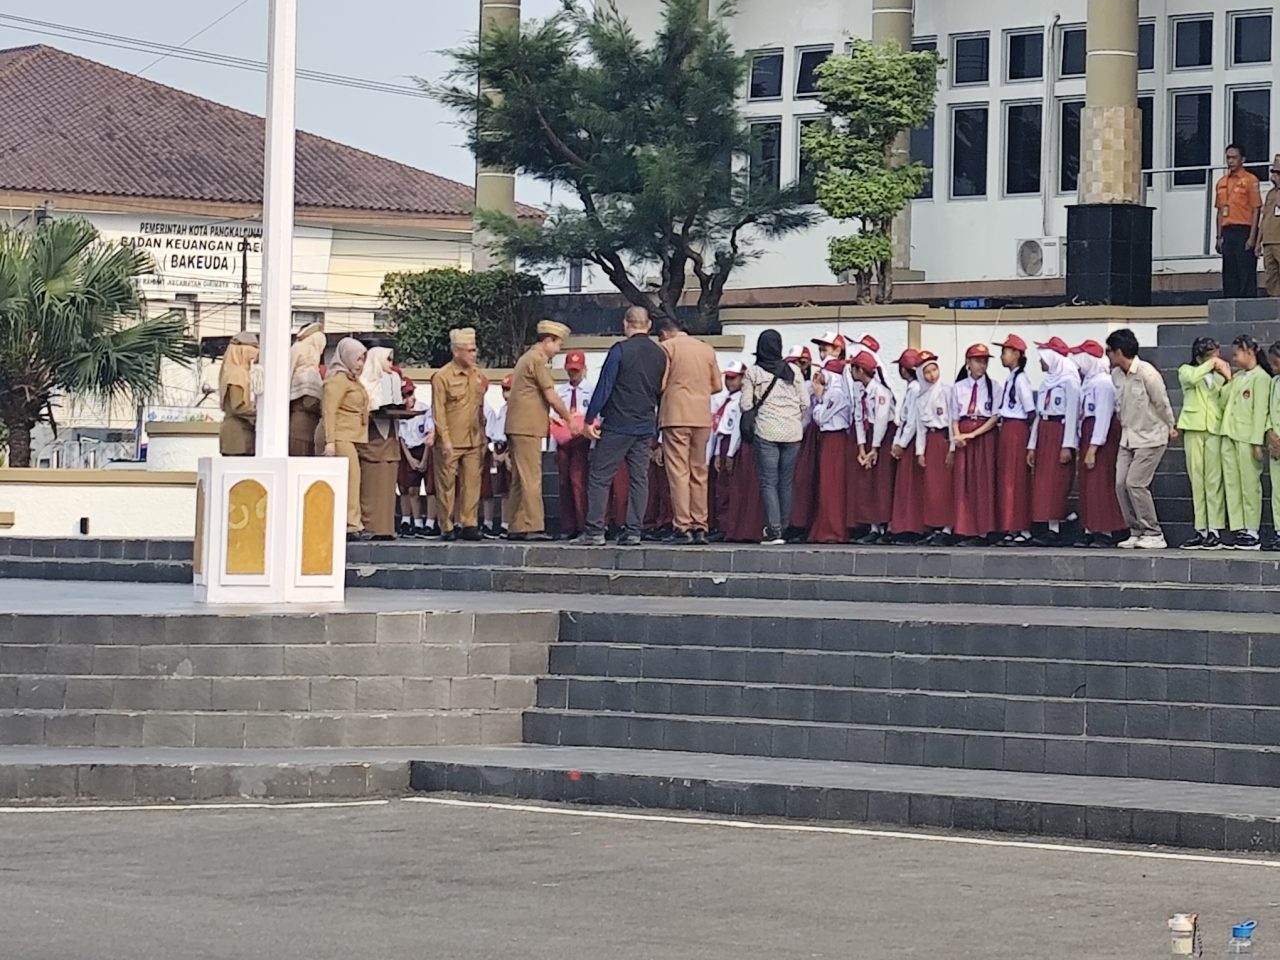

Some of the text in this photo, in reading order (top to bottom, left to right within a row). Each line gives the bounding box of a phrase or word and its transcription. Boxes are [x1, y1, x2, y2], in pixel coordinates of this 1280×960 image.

[139, 222, 187, 235] PEMERINTAH
[189, 224, 208, 237] KOTA
[120, 236, 262, 253] BADAN KEUANGAN DAE
[171, 254, 228, 270] BAKEUDA
